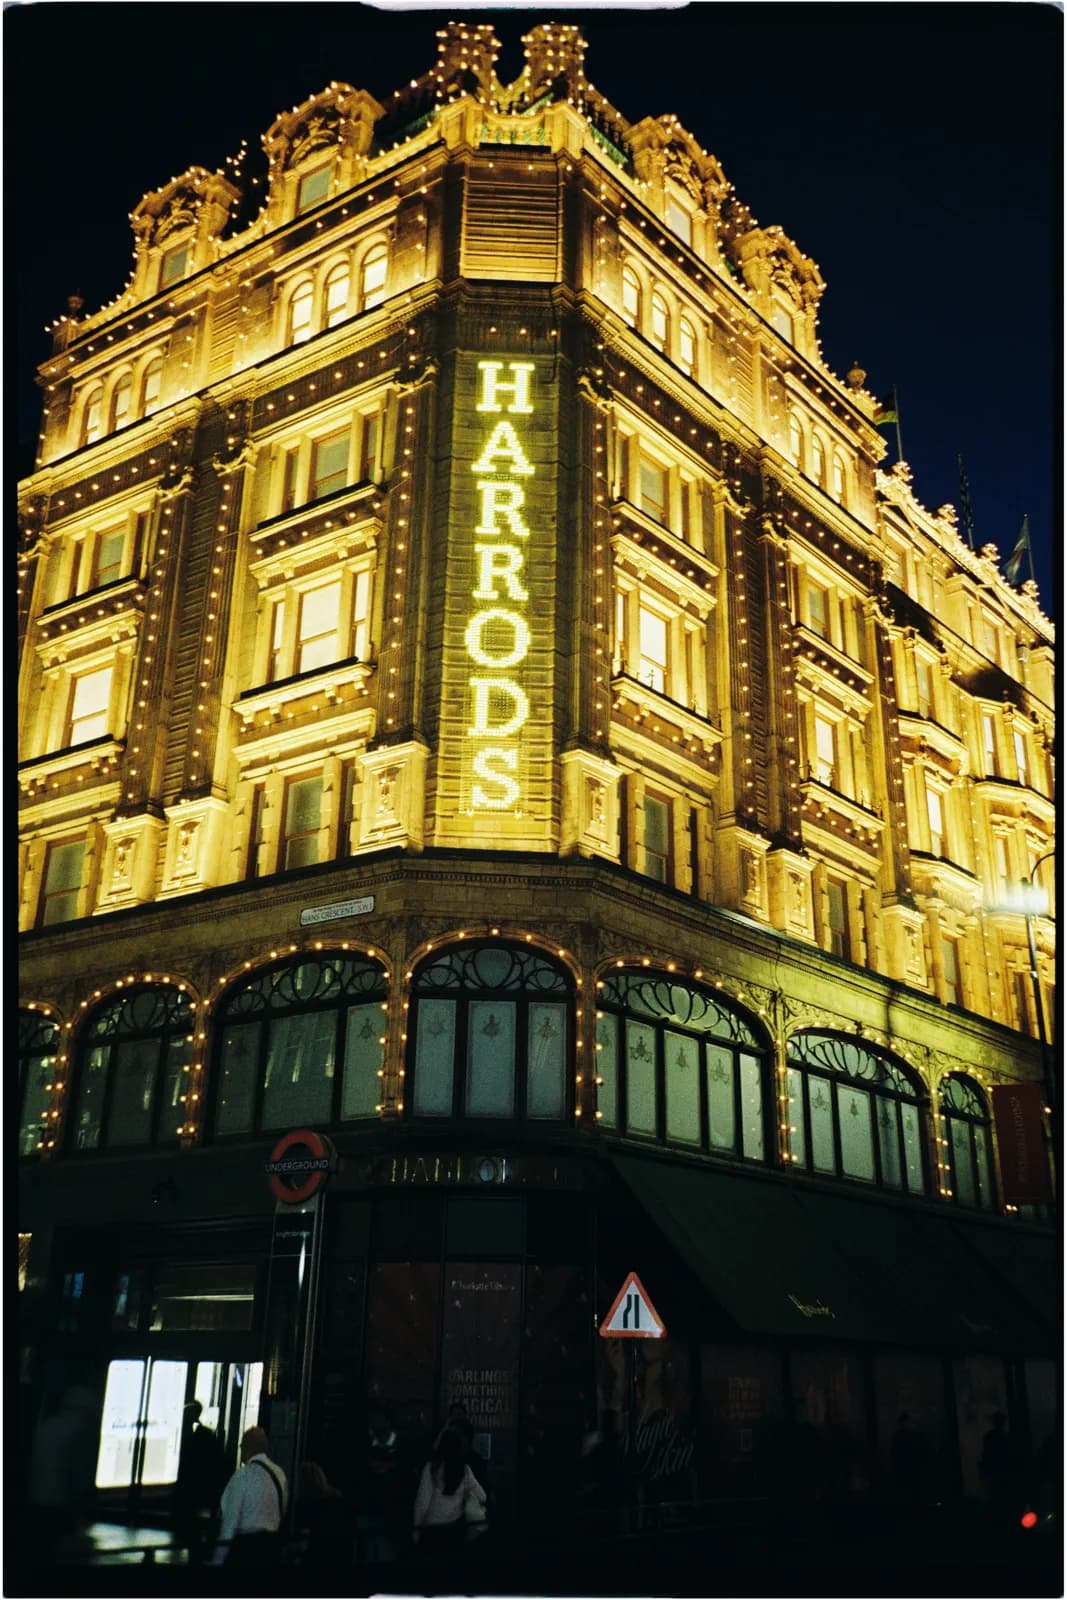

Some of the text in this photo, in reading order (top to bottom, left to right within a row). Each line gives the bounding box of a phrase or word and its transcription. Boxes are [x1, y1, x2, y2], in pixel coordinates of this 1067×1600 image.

[465, 360, 535, 809] HARRODS
[302, 912, 320, 923] HANS
[321, 906, 354, 919] CRESCENT
[264, 1159, 329, 1173] UNDERGROUND
[448, 1384, 511, 1397] OMETHIN
